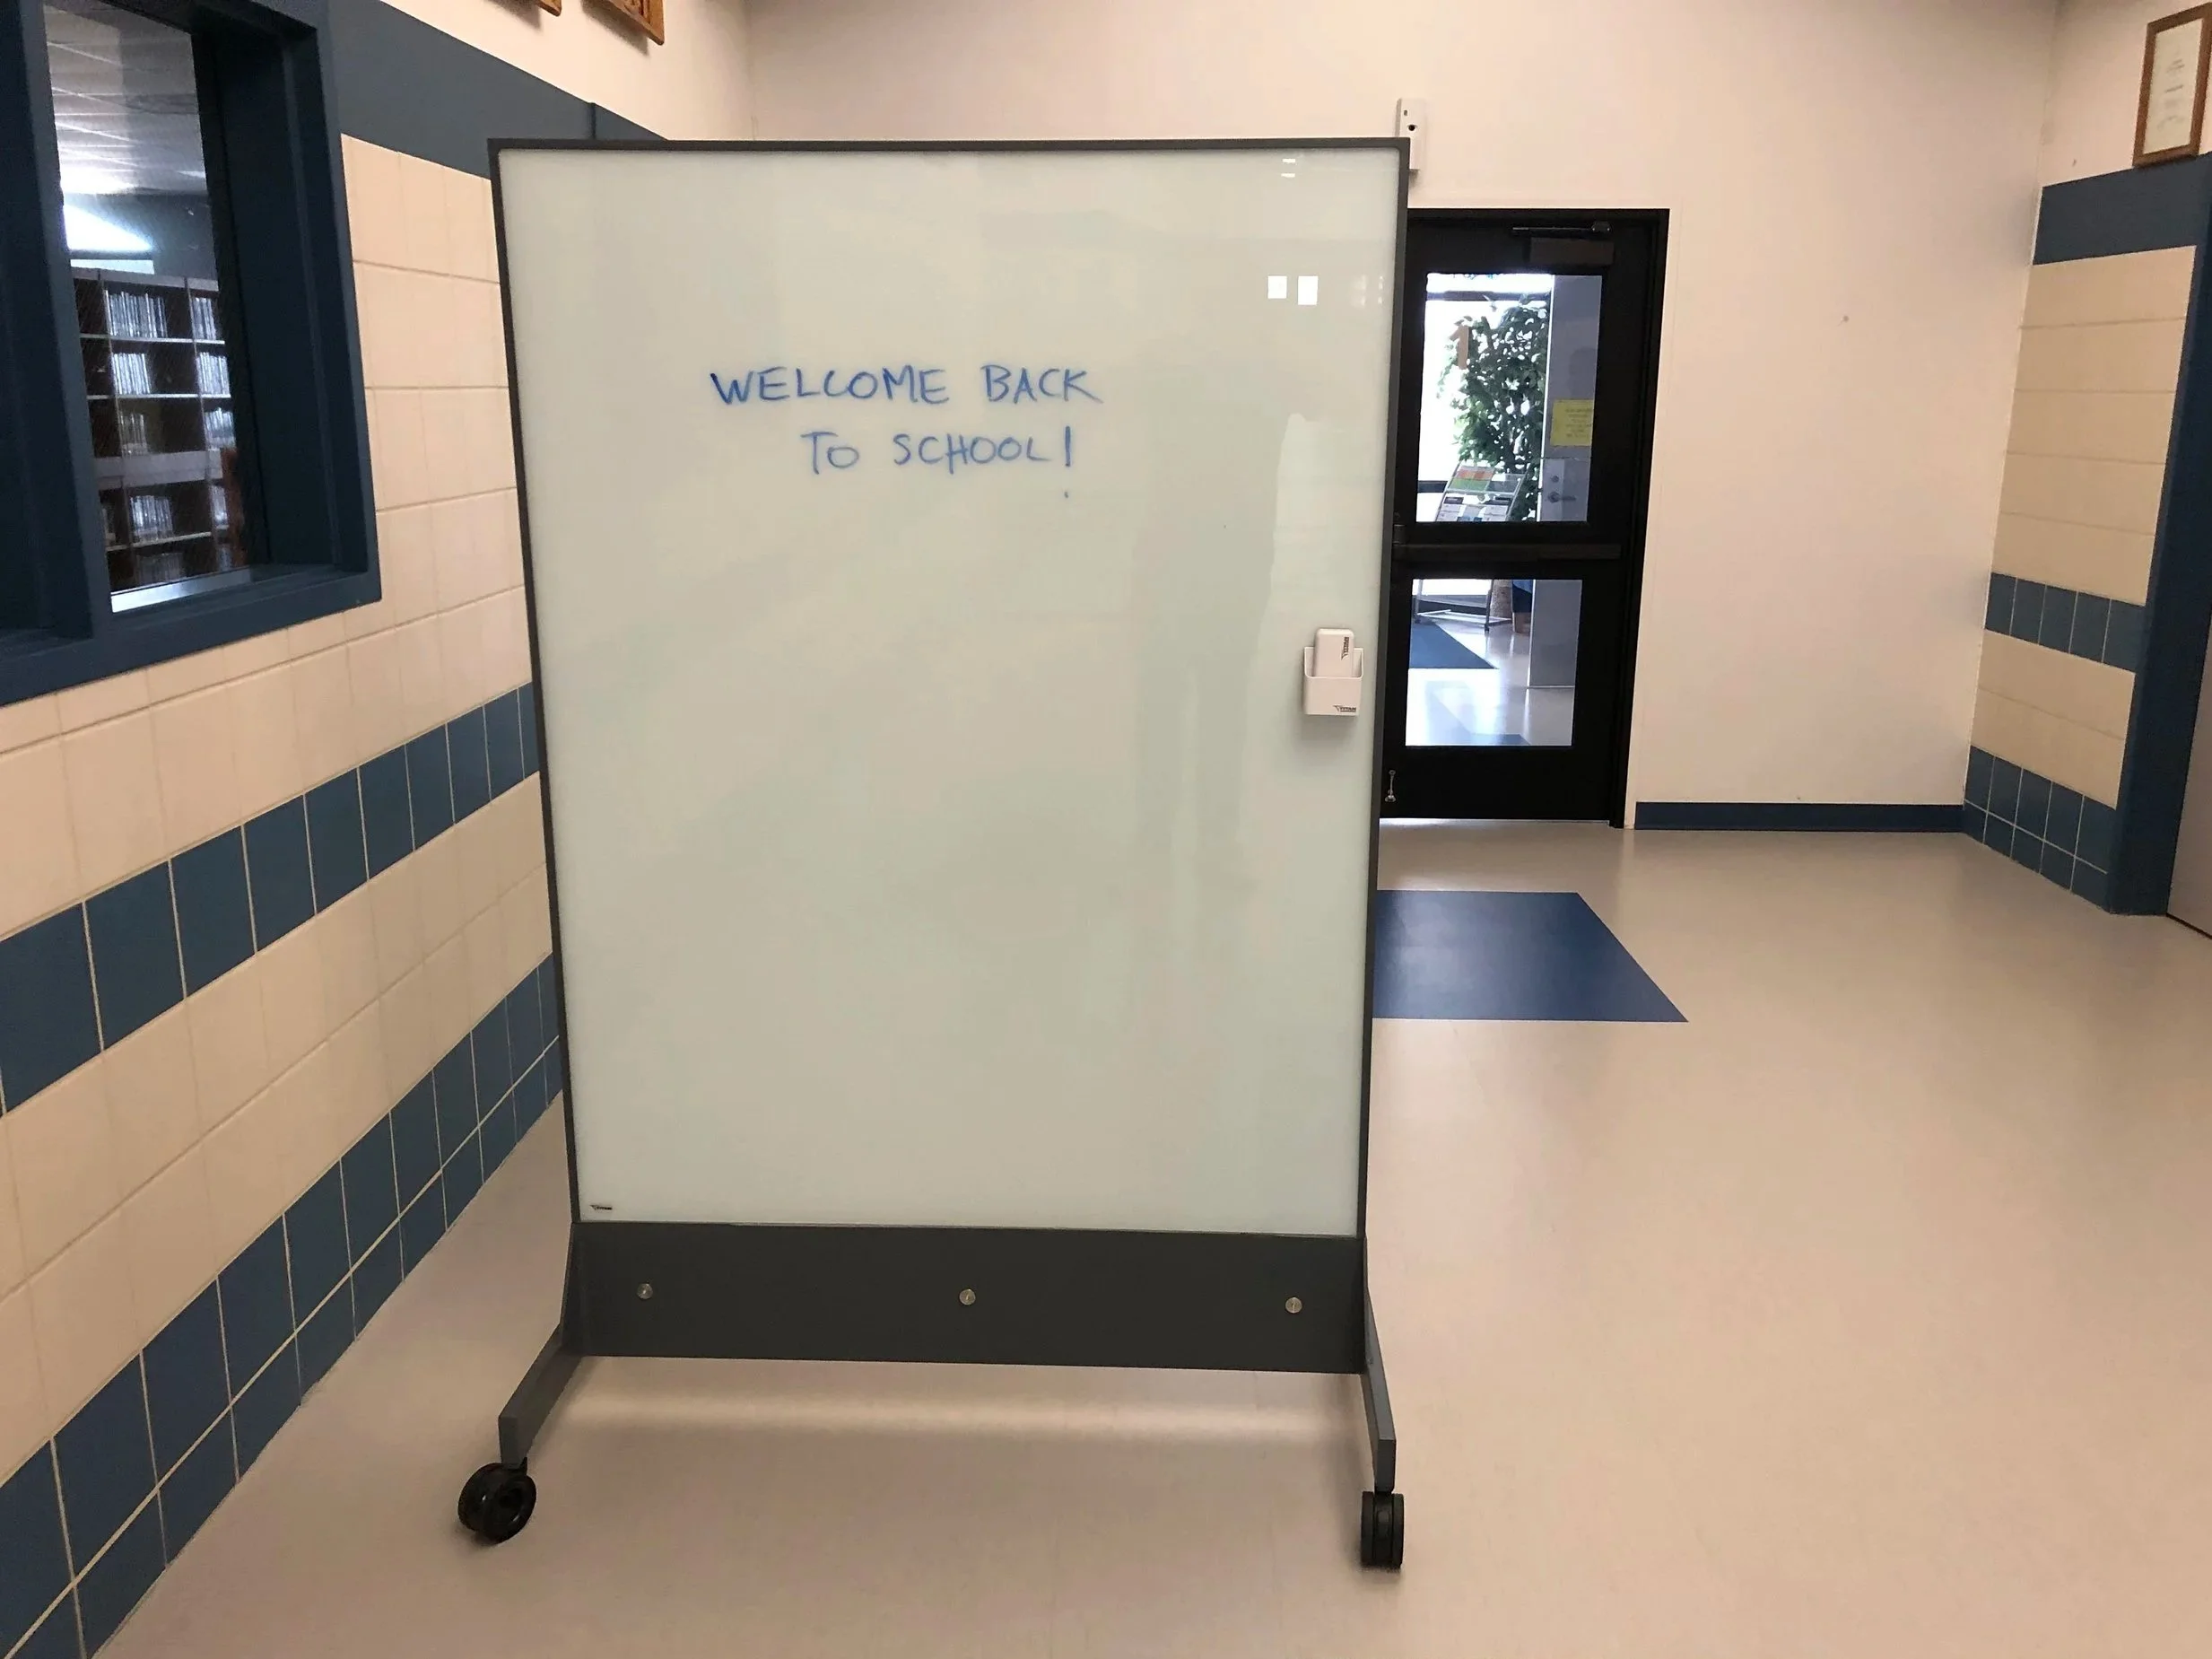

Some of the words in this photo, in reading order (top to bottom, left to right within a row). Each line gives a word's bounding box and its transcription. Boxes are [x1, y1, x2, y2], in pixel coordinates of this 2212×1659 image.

[710, 364, 951, 406] WELCOME
[980, 364, 1104, 406] BACK
[800, 431, 860, 475] TO
